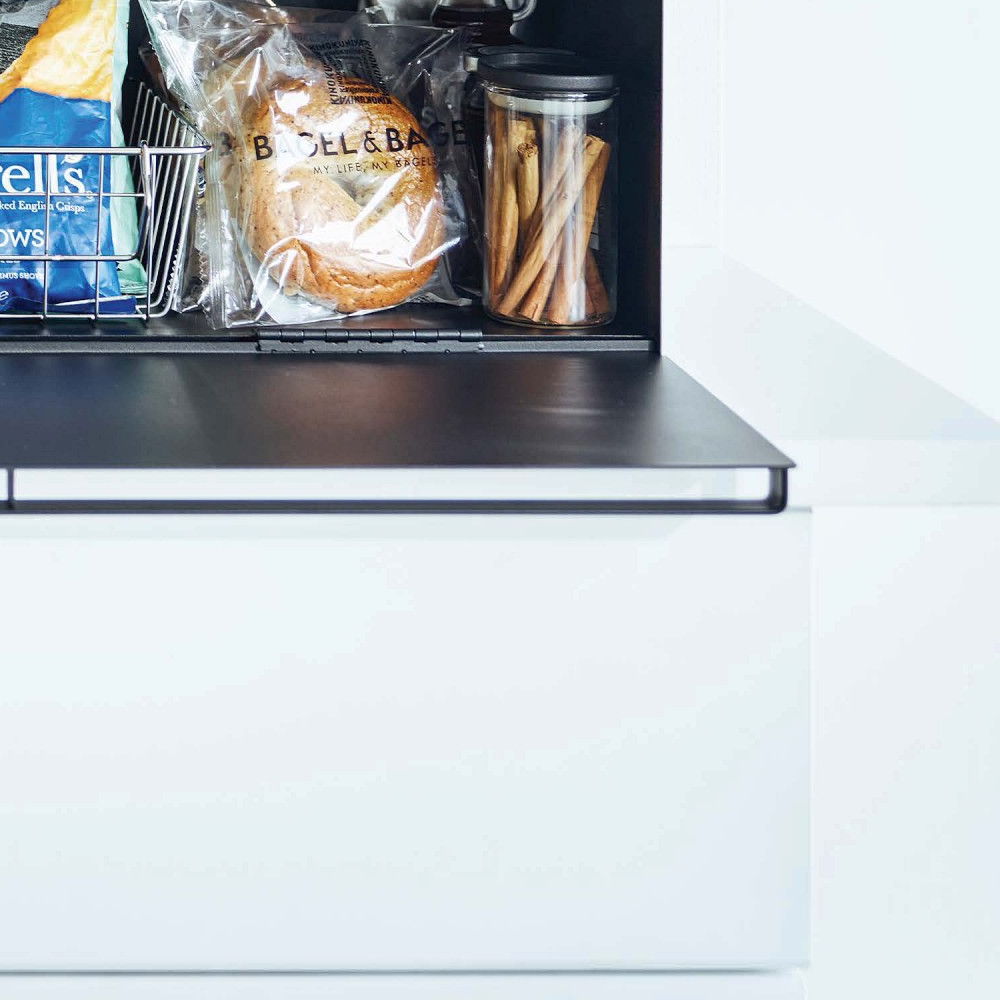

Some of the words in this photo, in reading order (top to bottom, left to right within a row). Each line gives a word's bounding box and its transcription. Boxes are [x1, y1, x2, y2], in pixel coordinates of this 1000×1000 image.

[313, 166, 329, 174] MY
[372, 160, 388, 170] MY
[56, 201, 85, 214] Crisps
